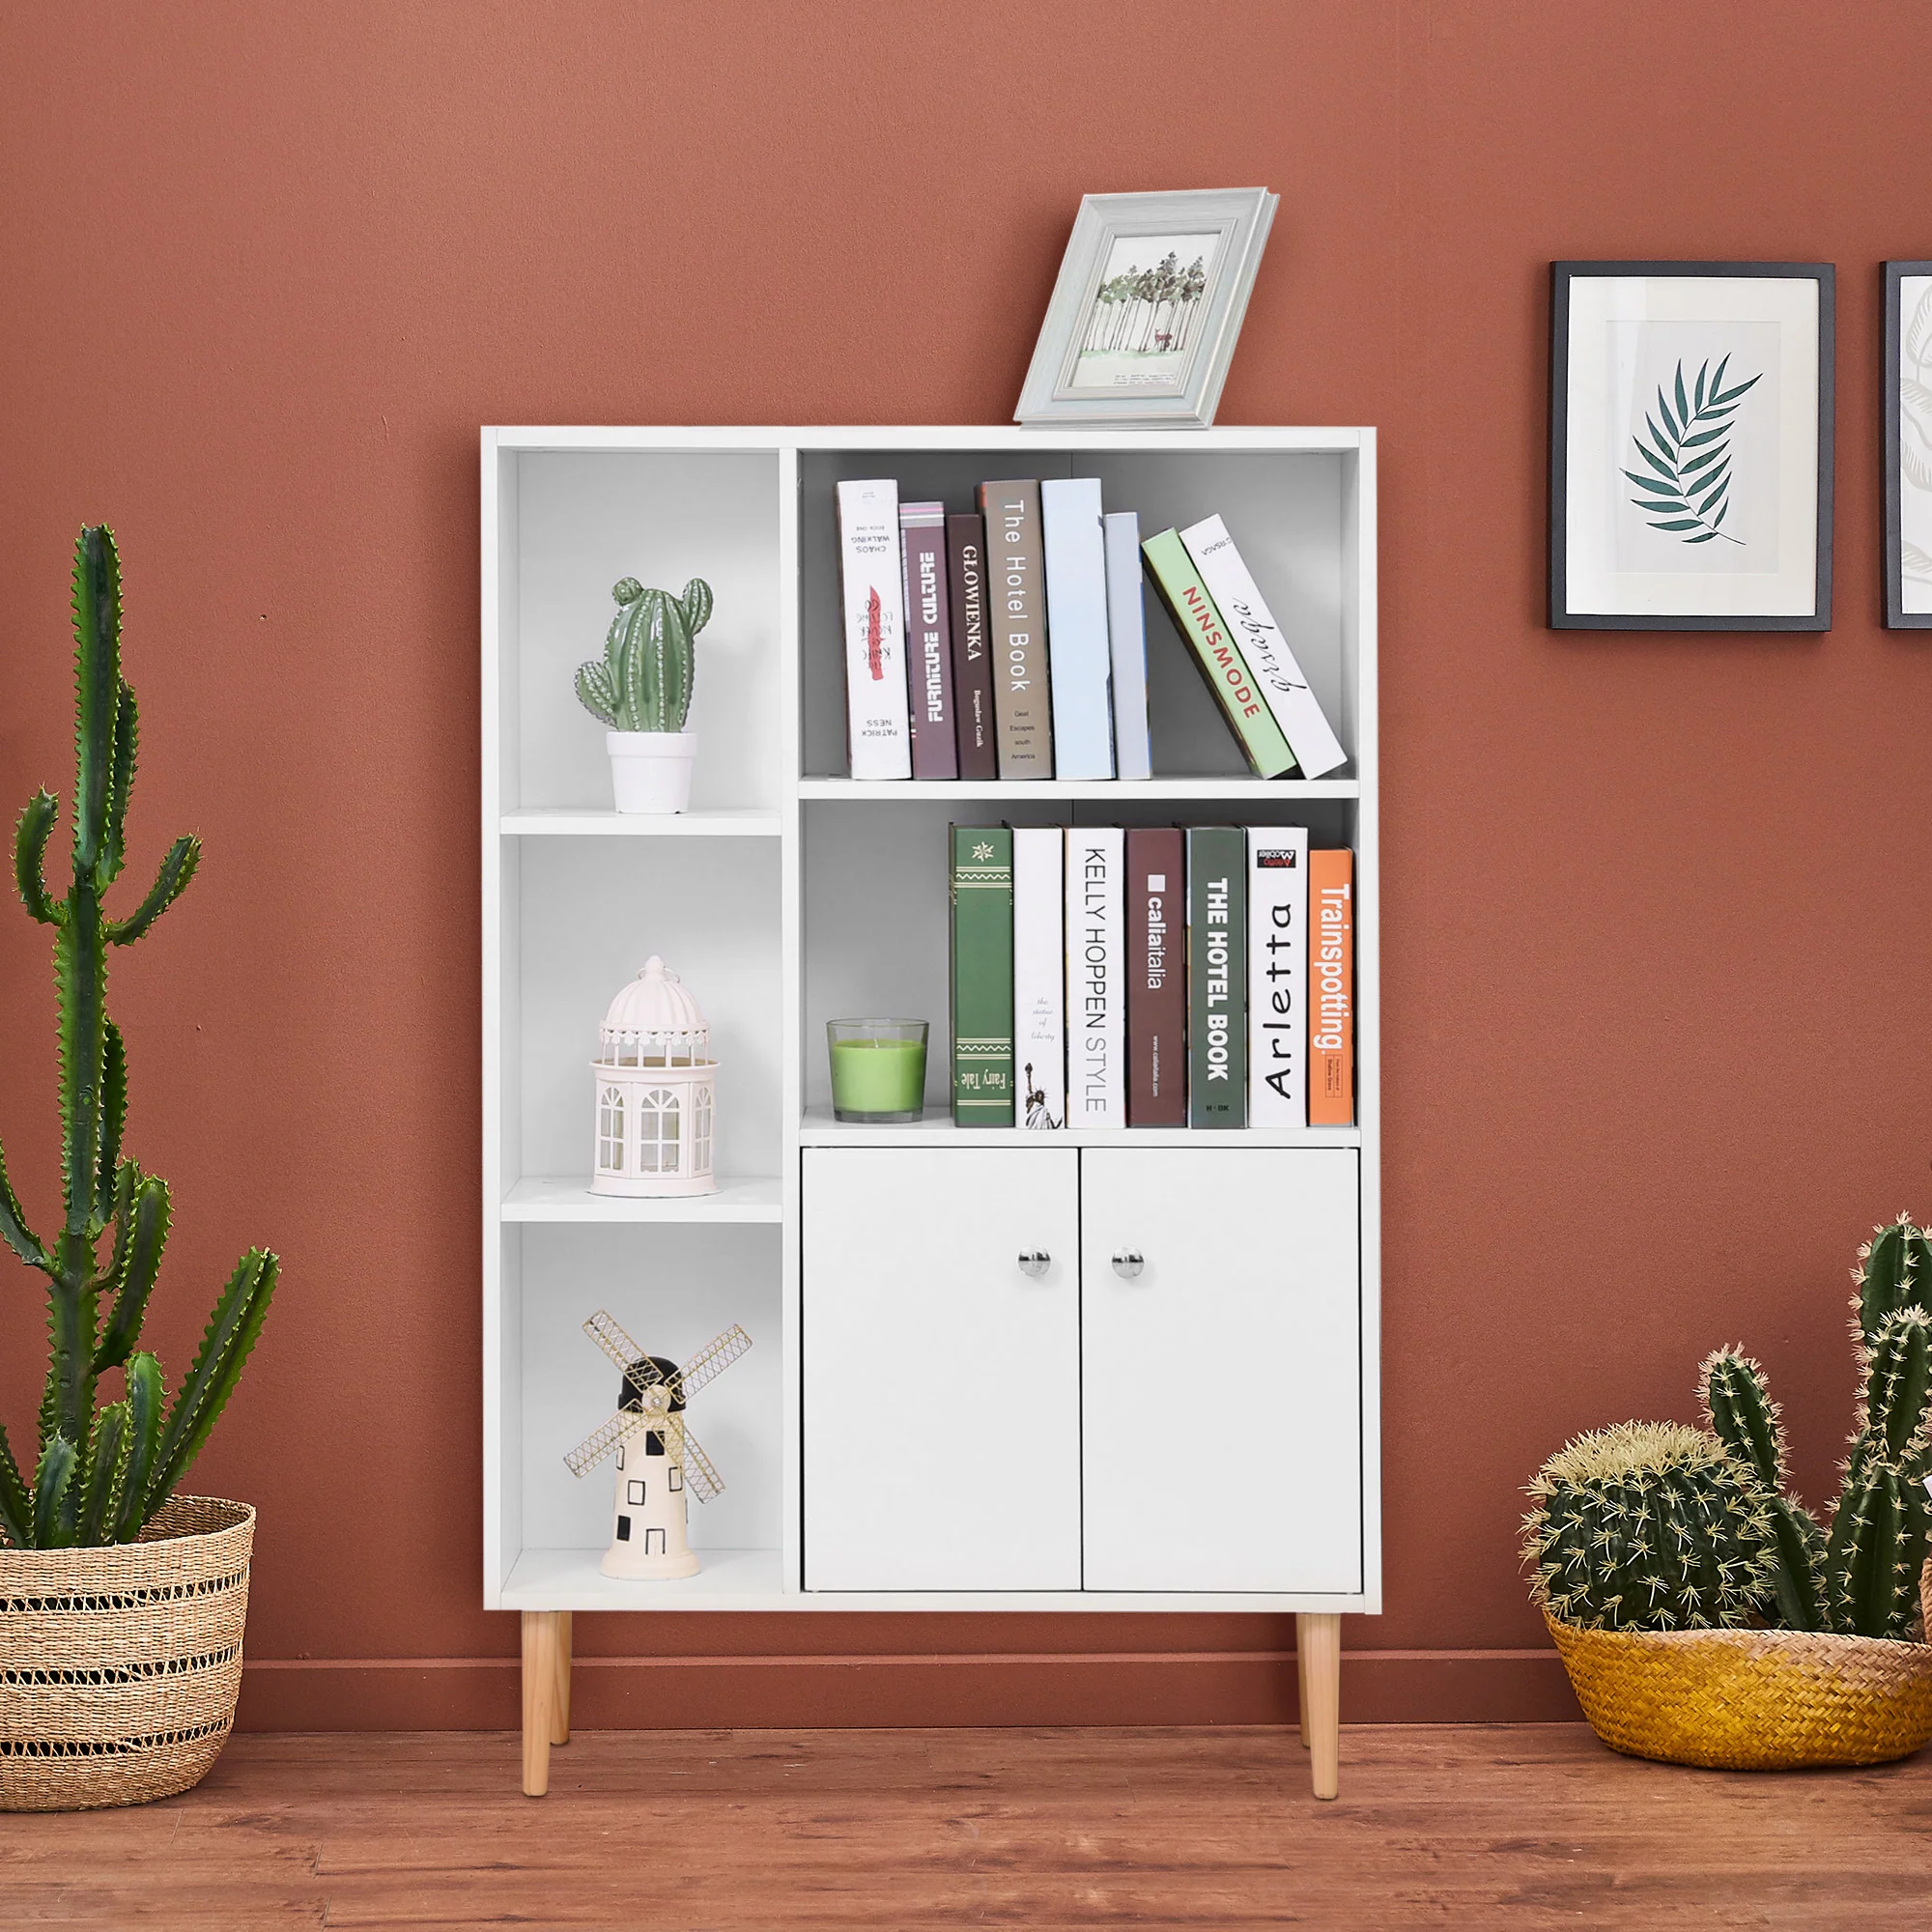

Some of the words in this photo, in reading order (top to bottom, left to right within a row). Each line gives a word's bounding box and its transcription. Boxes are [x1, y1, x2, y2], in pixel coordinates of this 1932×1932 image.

[850, 535, 891, 544] WALKING
[855, 545, 887, 554] CHAOS
[1004, 499, 1025, 543] The
[919, 552, 938, 625] CULTURE
[1007, 556, 1029, 619] Hotel
[1009, 633, 1031, 692] Book
[1182, 586, 1260, 718] NINSMODE
[861, 728, 897, 738] PATRICK
[867, 718, 893, 727] NESS
[1009, 724, 1036, 733] Escapes
[1085, 848, 1106, 921] KELLY
[1207, 877, 1229, 924] THE
[1147, 896, 1167, 989] caliaitalia
[1207, 931, 1229, 1008] HOTEL
[1085, 928, 1107, 1029] HOPPEN
[1263, 904, 1292, 1099] Arletta
[1085, 1037, 1107, 1113] STYLE
[1207, 1014, 1229, 1081] BOOK
[960, 1072, 980, 1090] Tale
[981, 1068, 1007, 1091] Fairy
